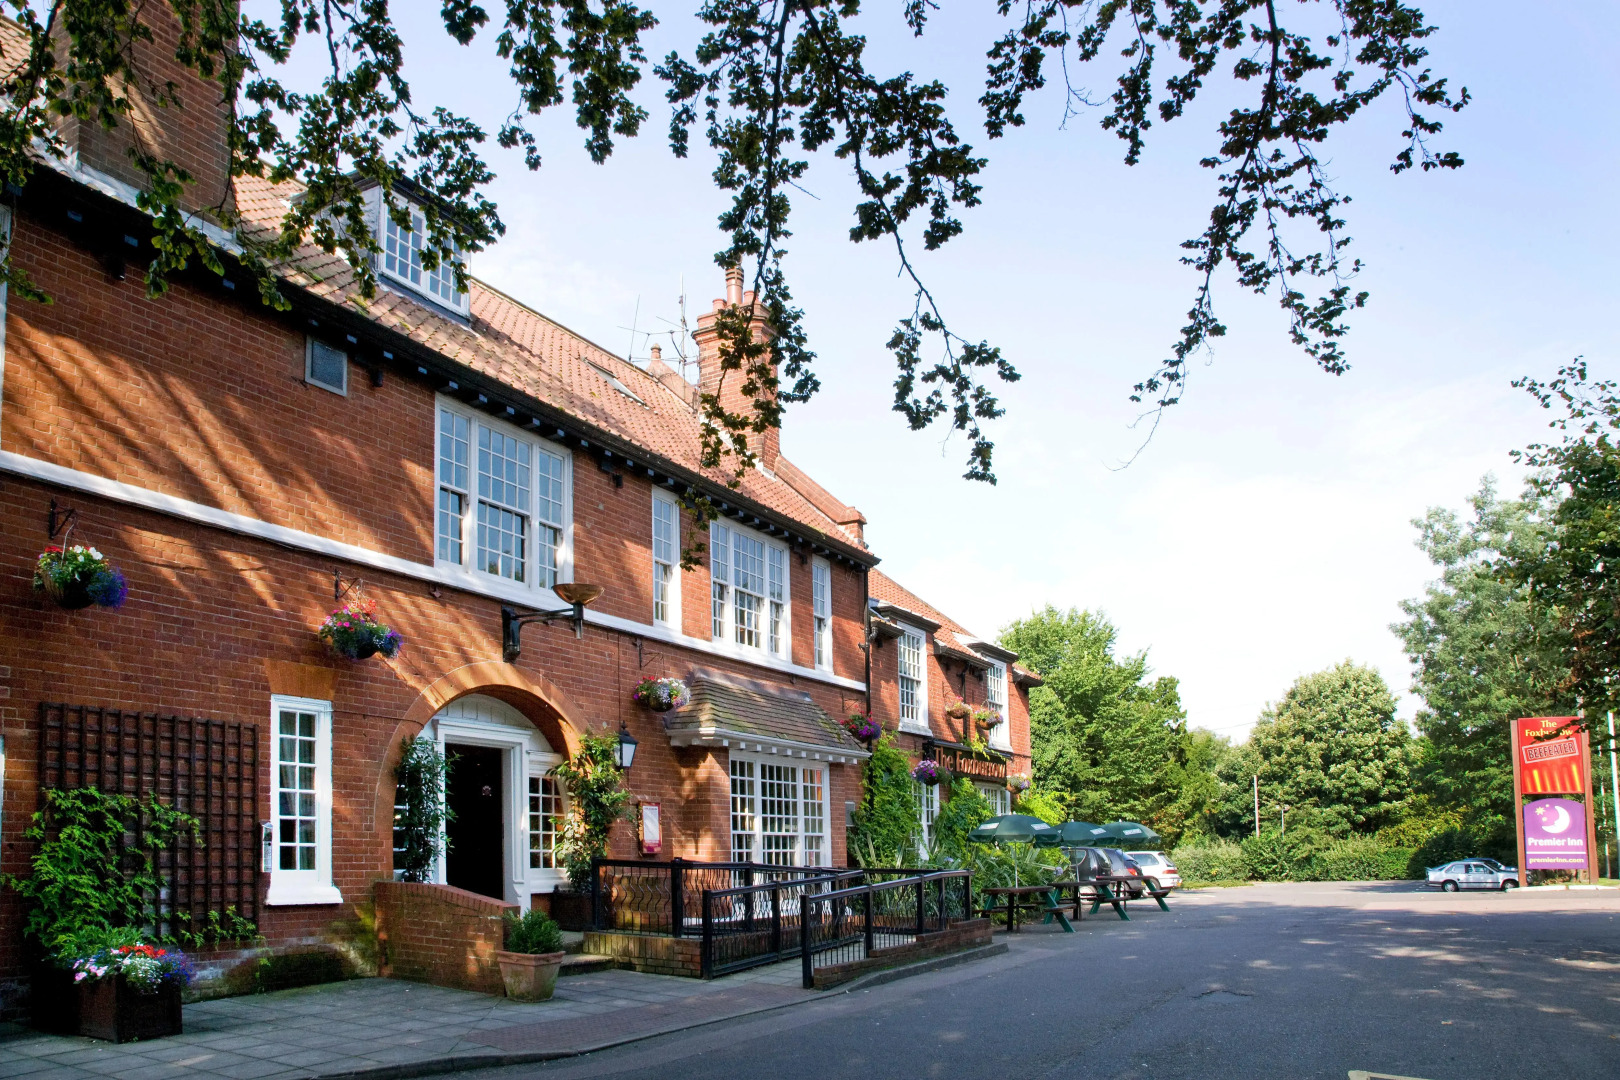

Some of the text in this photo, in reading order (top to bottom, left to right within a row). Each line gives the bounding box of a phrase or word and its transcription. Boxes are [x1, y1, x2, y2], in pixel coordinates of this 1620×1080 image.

[1540, 719, 1557, 728] The
[1525, 728, 1573, 736] Foxbuow
[1527, 742, 1575, 760] BEEFEATER
[934, 745, 1006, 778] The Foxburrow
[1527, 837, 1584, 846] Premier Inn
